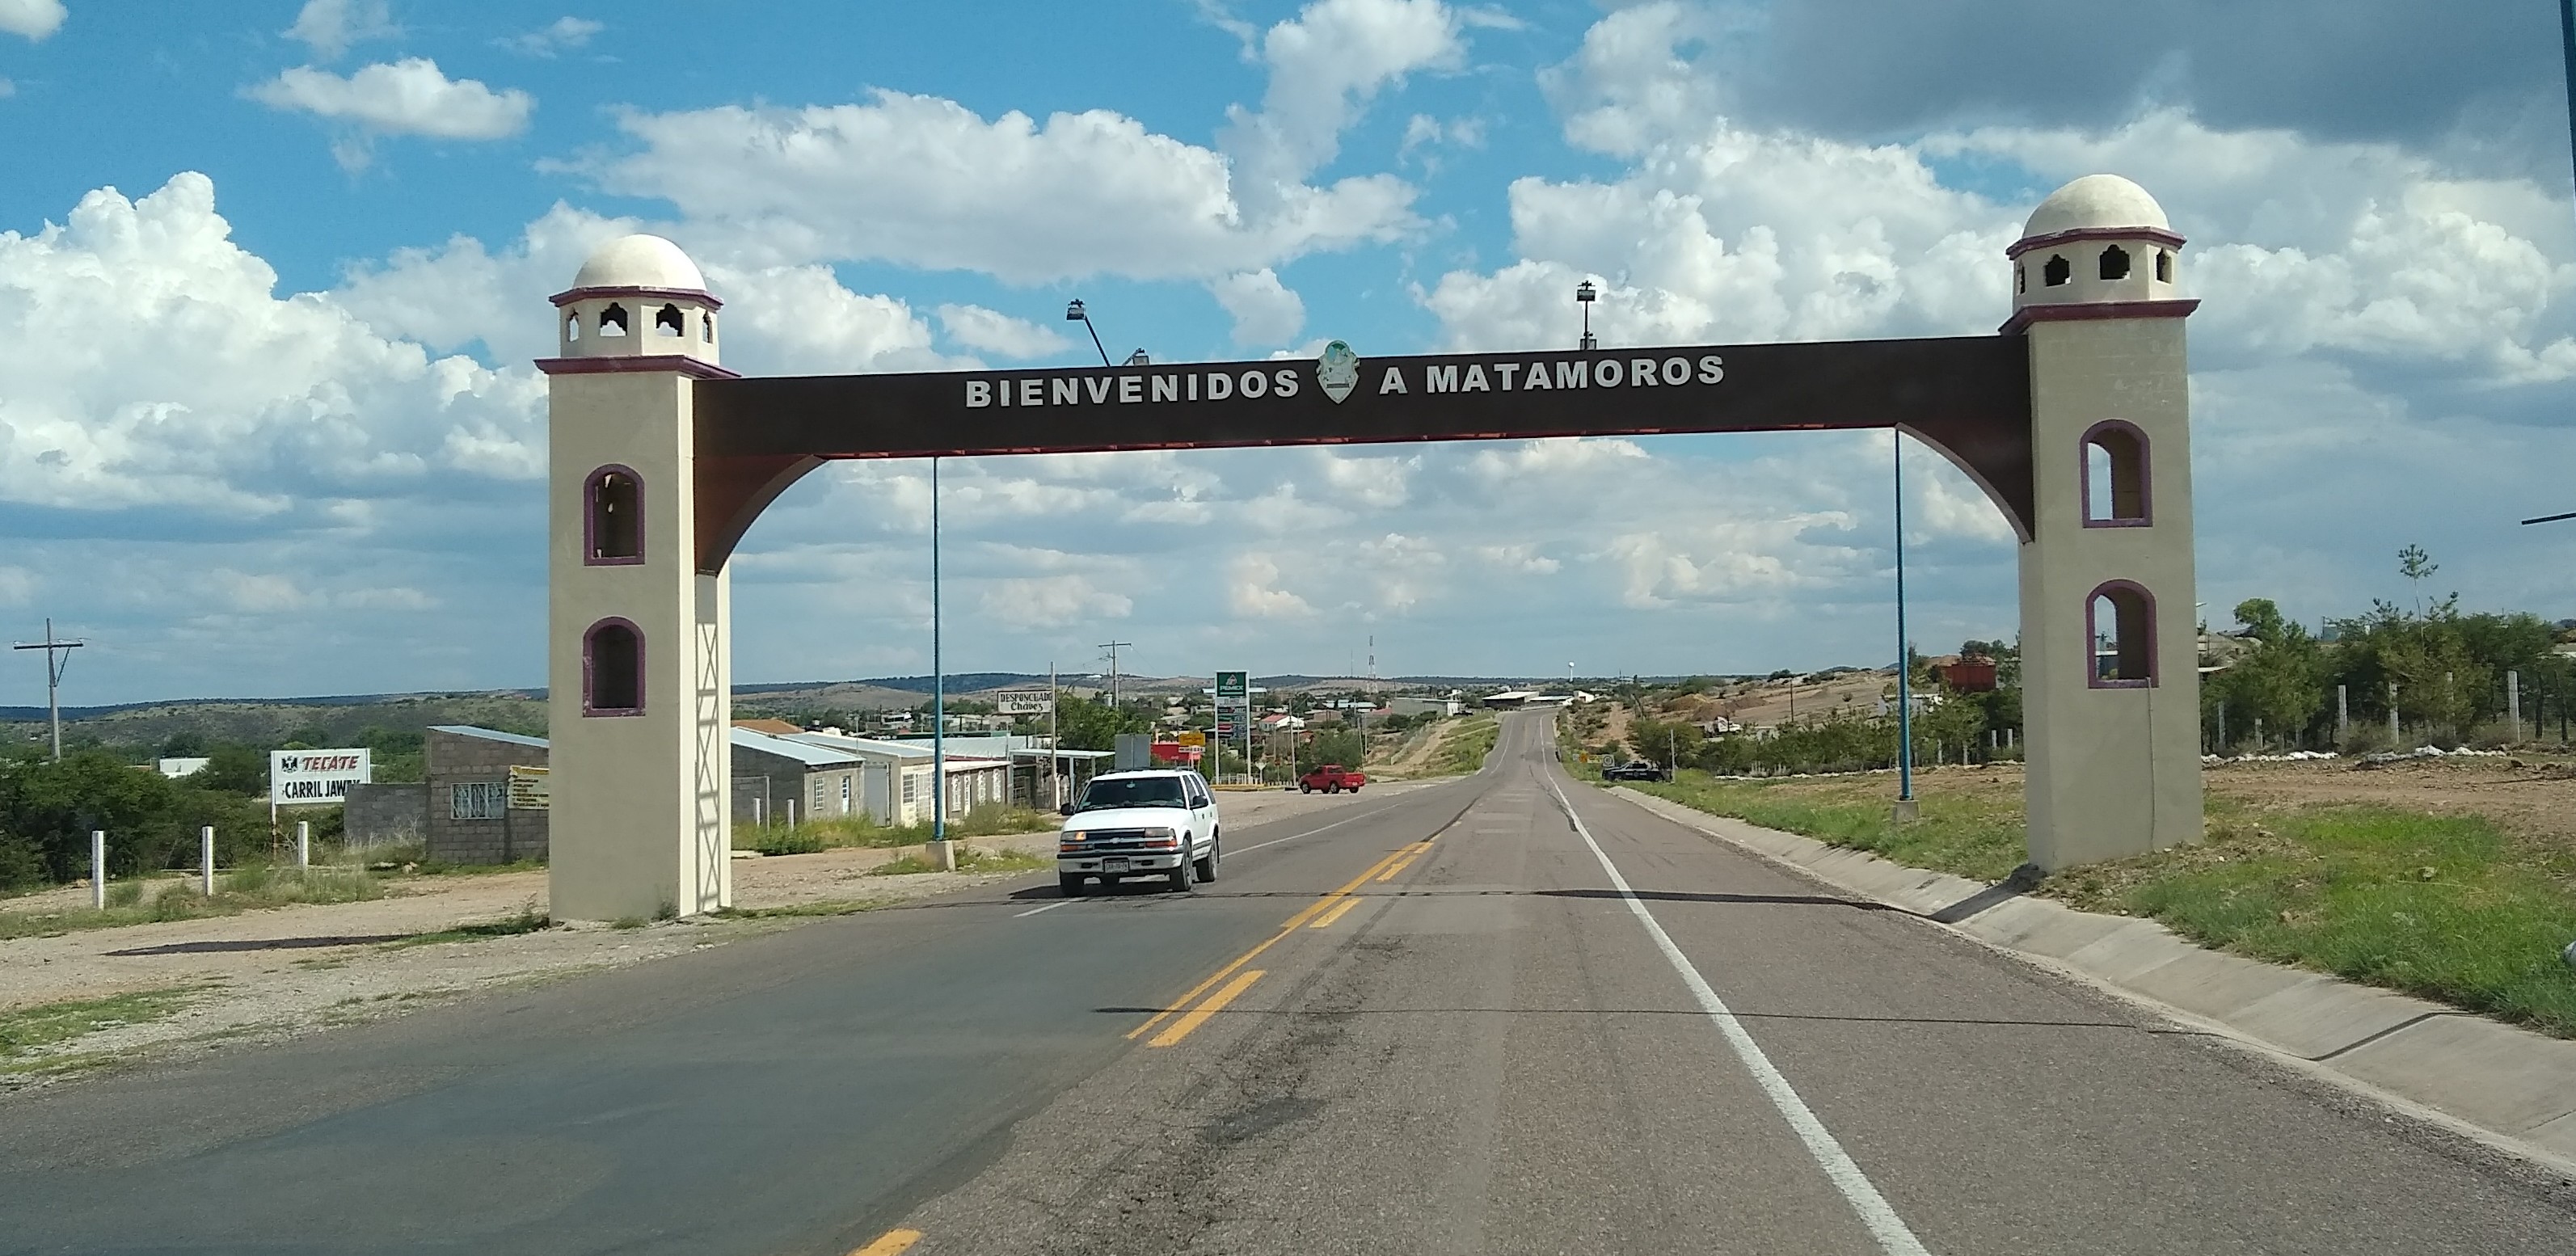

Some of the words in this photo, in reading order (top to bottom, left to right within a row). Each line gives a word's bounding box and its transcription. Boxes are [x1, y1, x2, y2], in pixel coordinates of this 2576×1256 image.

[965, 369, 1300, 408] BIENVENIDOS
[1379, 366, 1408, 395] A
[1426, 356, 1724, 394] MATAMOROS
[302, 756, 360, 770] TECATE
[285, 781, 323, 799] CARRIL
[325, 779, 360, 798] JAW
